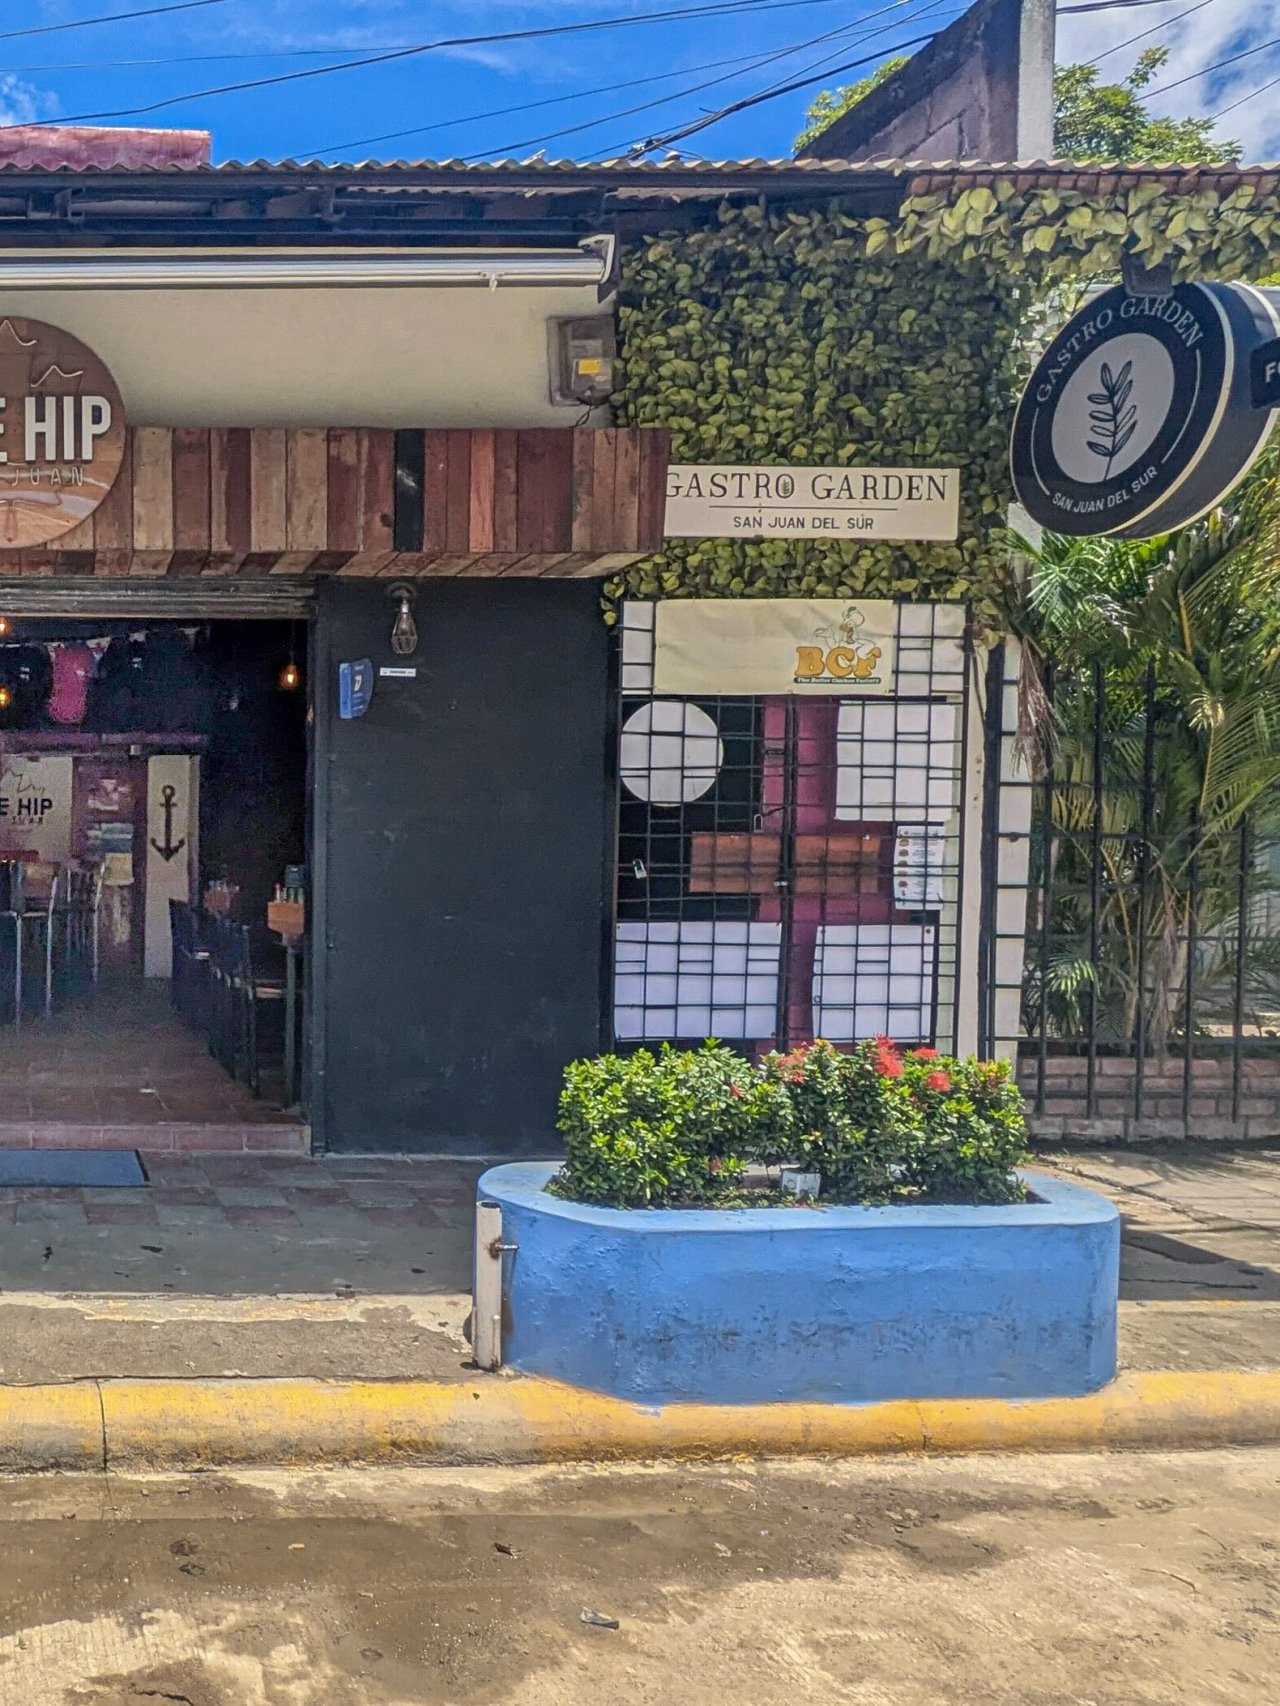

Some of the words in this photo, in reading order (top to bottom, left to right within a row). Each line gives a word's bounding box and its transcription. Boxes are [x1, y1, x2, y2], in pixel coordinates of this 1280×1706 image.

[1036, 309, 1113, 402] GASTRO
[1120, 296, 1204, 348] GARDEN
[25, 395, 112, 462] HIP
[11, 466, 84, 487] JUAN
[665, 472, 795, 499] GASTRO
[811, 474, 949, 501] GARDEN
[1052, 492, 1073, 511] SAN
[1073, 498, 1105, 513] JUAN
[1107, 490, 1131, 509] DEL
[1132, 466, 1159, 492] SUR
[733, 516, 762, 529] SAN
[768, 517, 805, 529] JUAN
[812, 517, 840, 530] DEL
[847, 517, 874, 531] SUR
[794, 646, 882, 678] BCF
[17, 797, 53, 816] HIP
